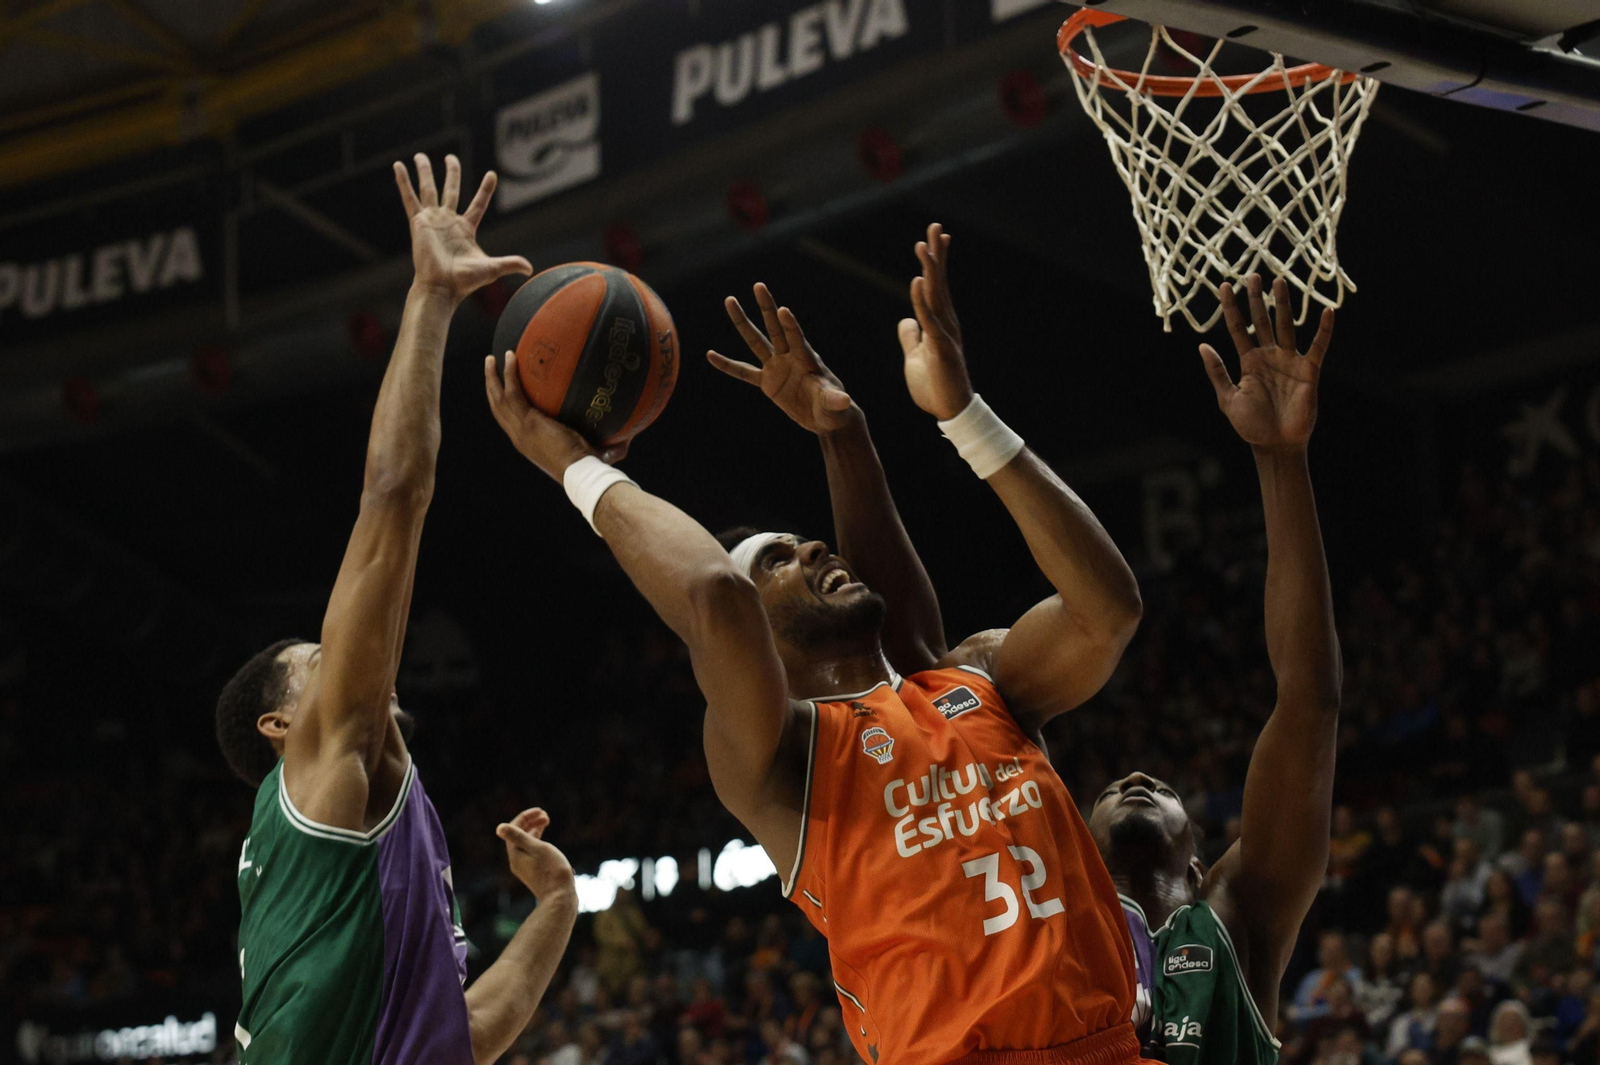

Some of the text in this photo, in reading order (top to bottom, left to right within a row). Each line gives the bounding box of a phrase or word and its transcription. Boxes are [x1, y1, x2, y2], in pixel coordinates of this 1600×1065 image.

[671, 0, 909, 126] PULEVA
[995, 756, 1024, 782] del
[962, 845, 1065, 936] 32
[1168, 954, 1187, 965] liga
[1168, 960, 1209, 971] endesa
